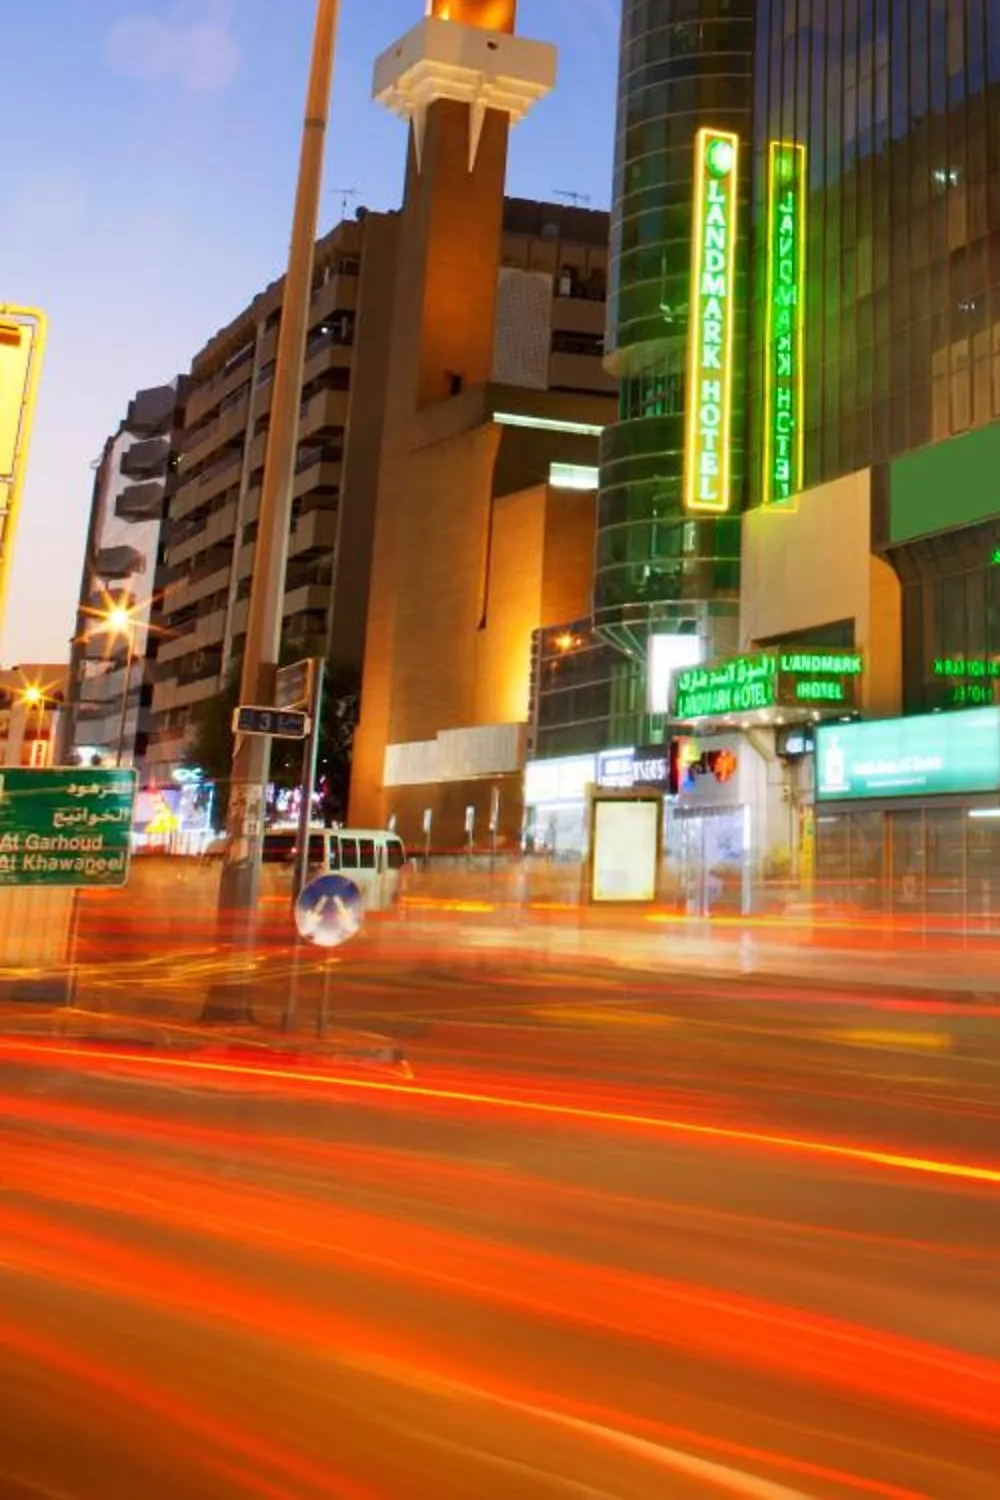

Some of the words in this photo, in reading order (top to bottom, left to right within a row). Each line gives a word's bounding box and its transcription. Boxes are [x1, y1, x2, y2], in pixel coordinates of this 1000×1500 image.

[701, 179, 726, 369] LANDMARK
[699, 379, 721, 501] HOTEL
[781, 654, 862, 674] LANDMARK
[796, 681, 843, 699] HOTEL
[25, 833, 103, 851] Garhoud
